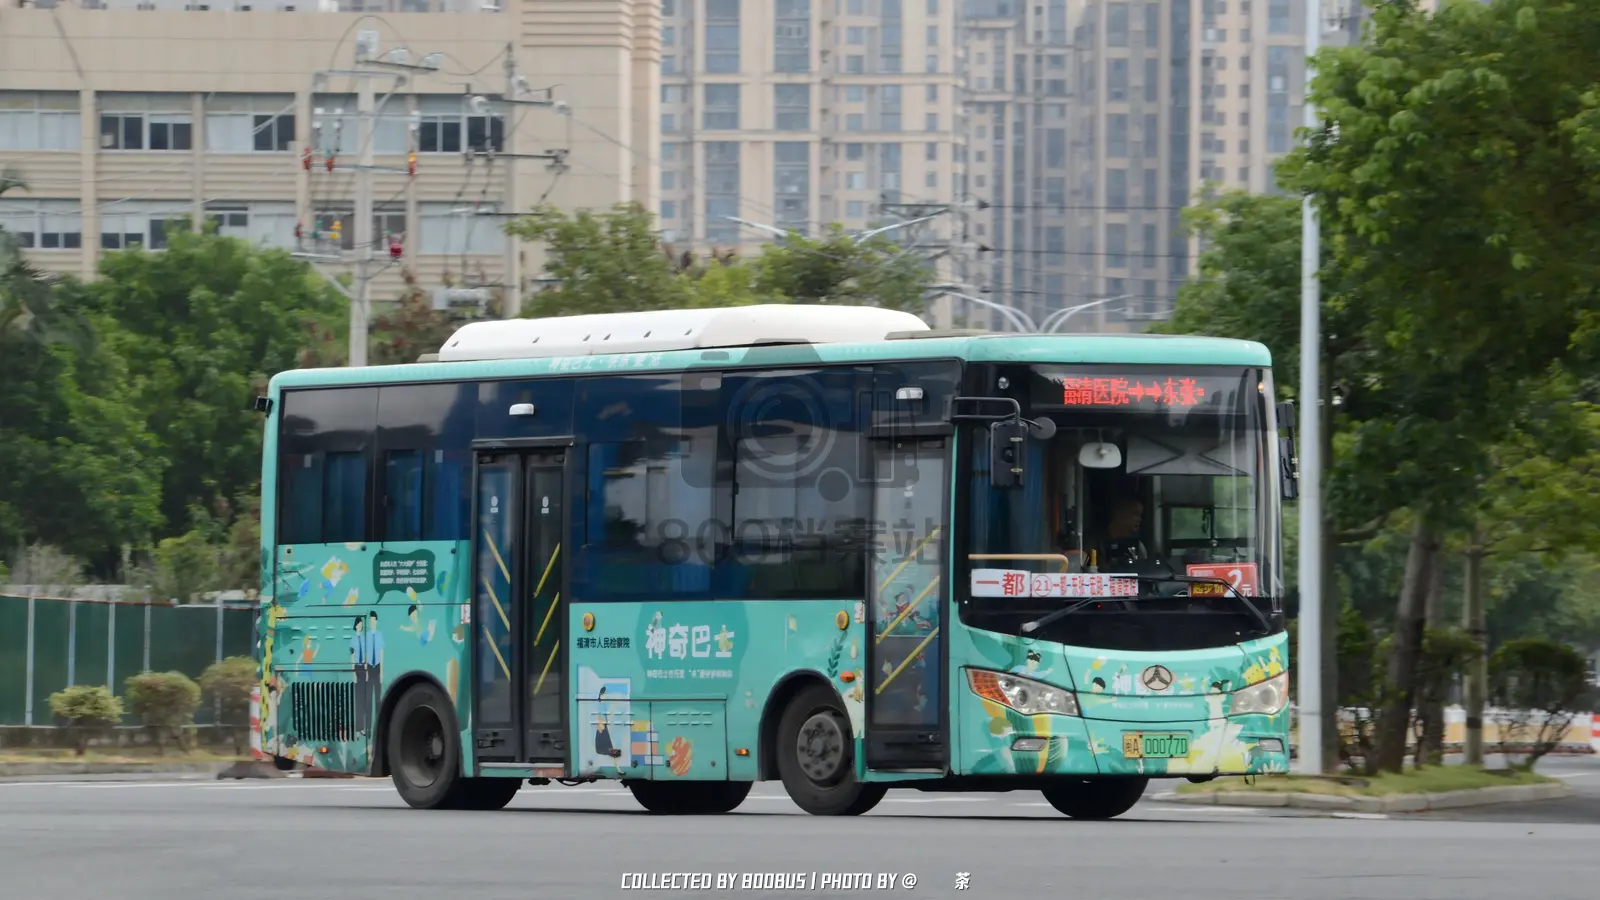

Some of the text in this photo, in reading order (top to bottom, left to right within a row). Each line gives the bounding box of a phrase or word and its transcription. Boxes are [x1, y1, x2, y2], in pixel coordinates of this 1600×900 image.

[976, 572, 1025, 597] 一都
[1034, 580, 1051, 592] 21
[576, 637, 630, 649] 福清市人民检察院
[645, 622, 735, 660] 神奇巴士
